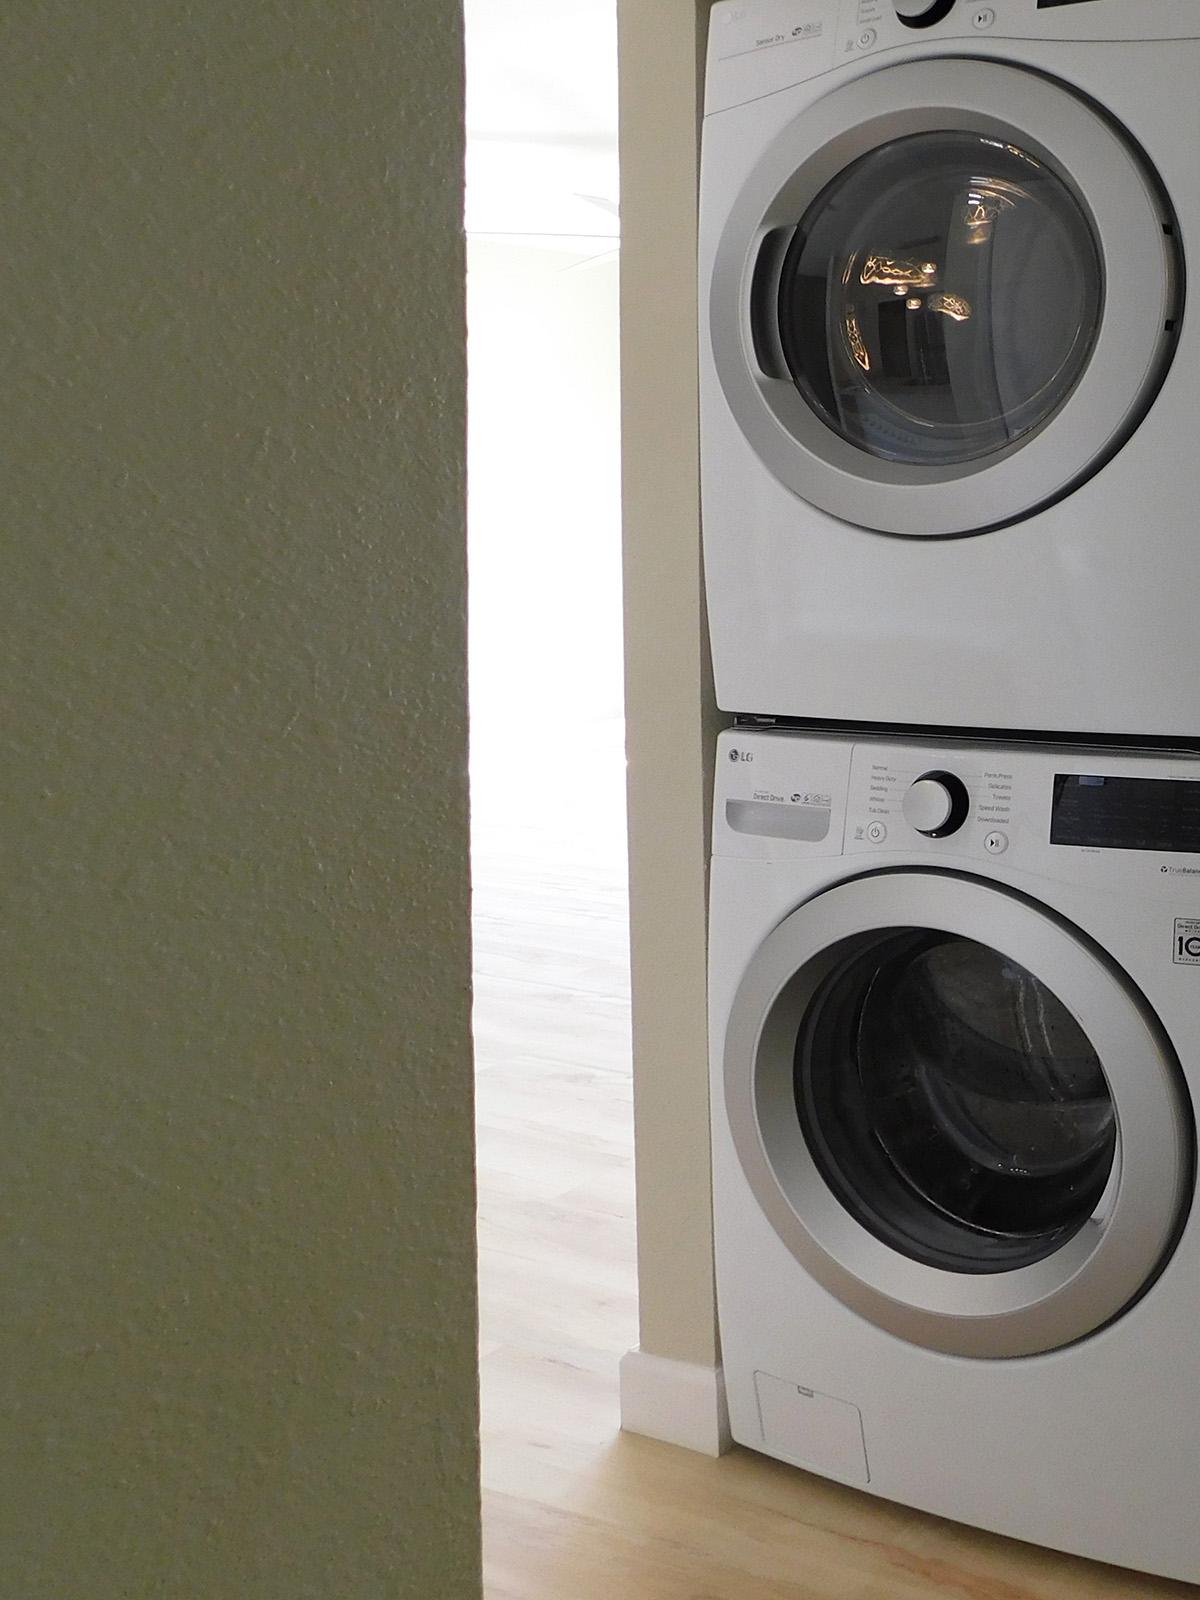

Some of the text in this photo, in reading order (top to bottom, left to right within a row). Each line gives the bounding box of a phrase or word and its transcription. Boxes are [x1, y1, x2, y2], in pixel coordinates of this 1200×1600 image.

[740, 751, 753, 762] LG
[753, 792, 785, 802] Direct Drive
